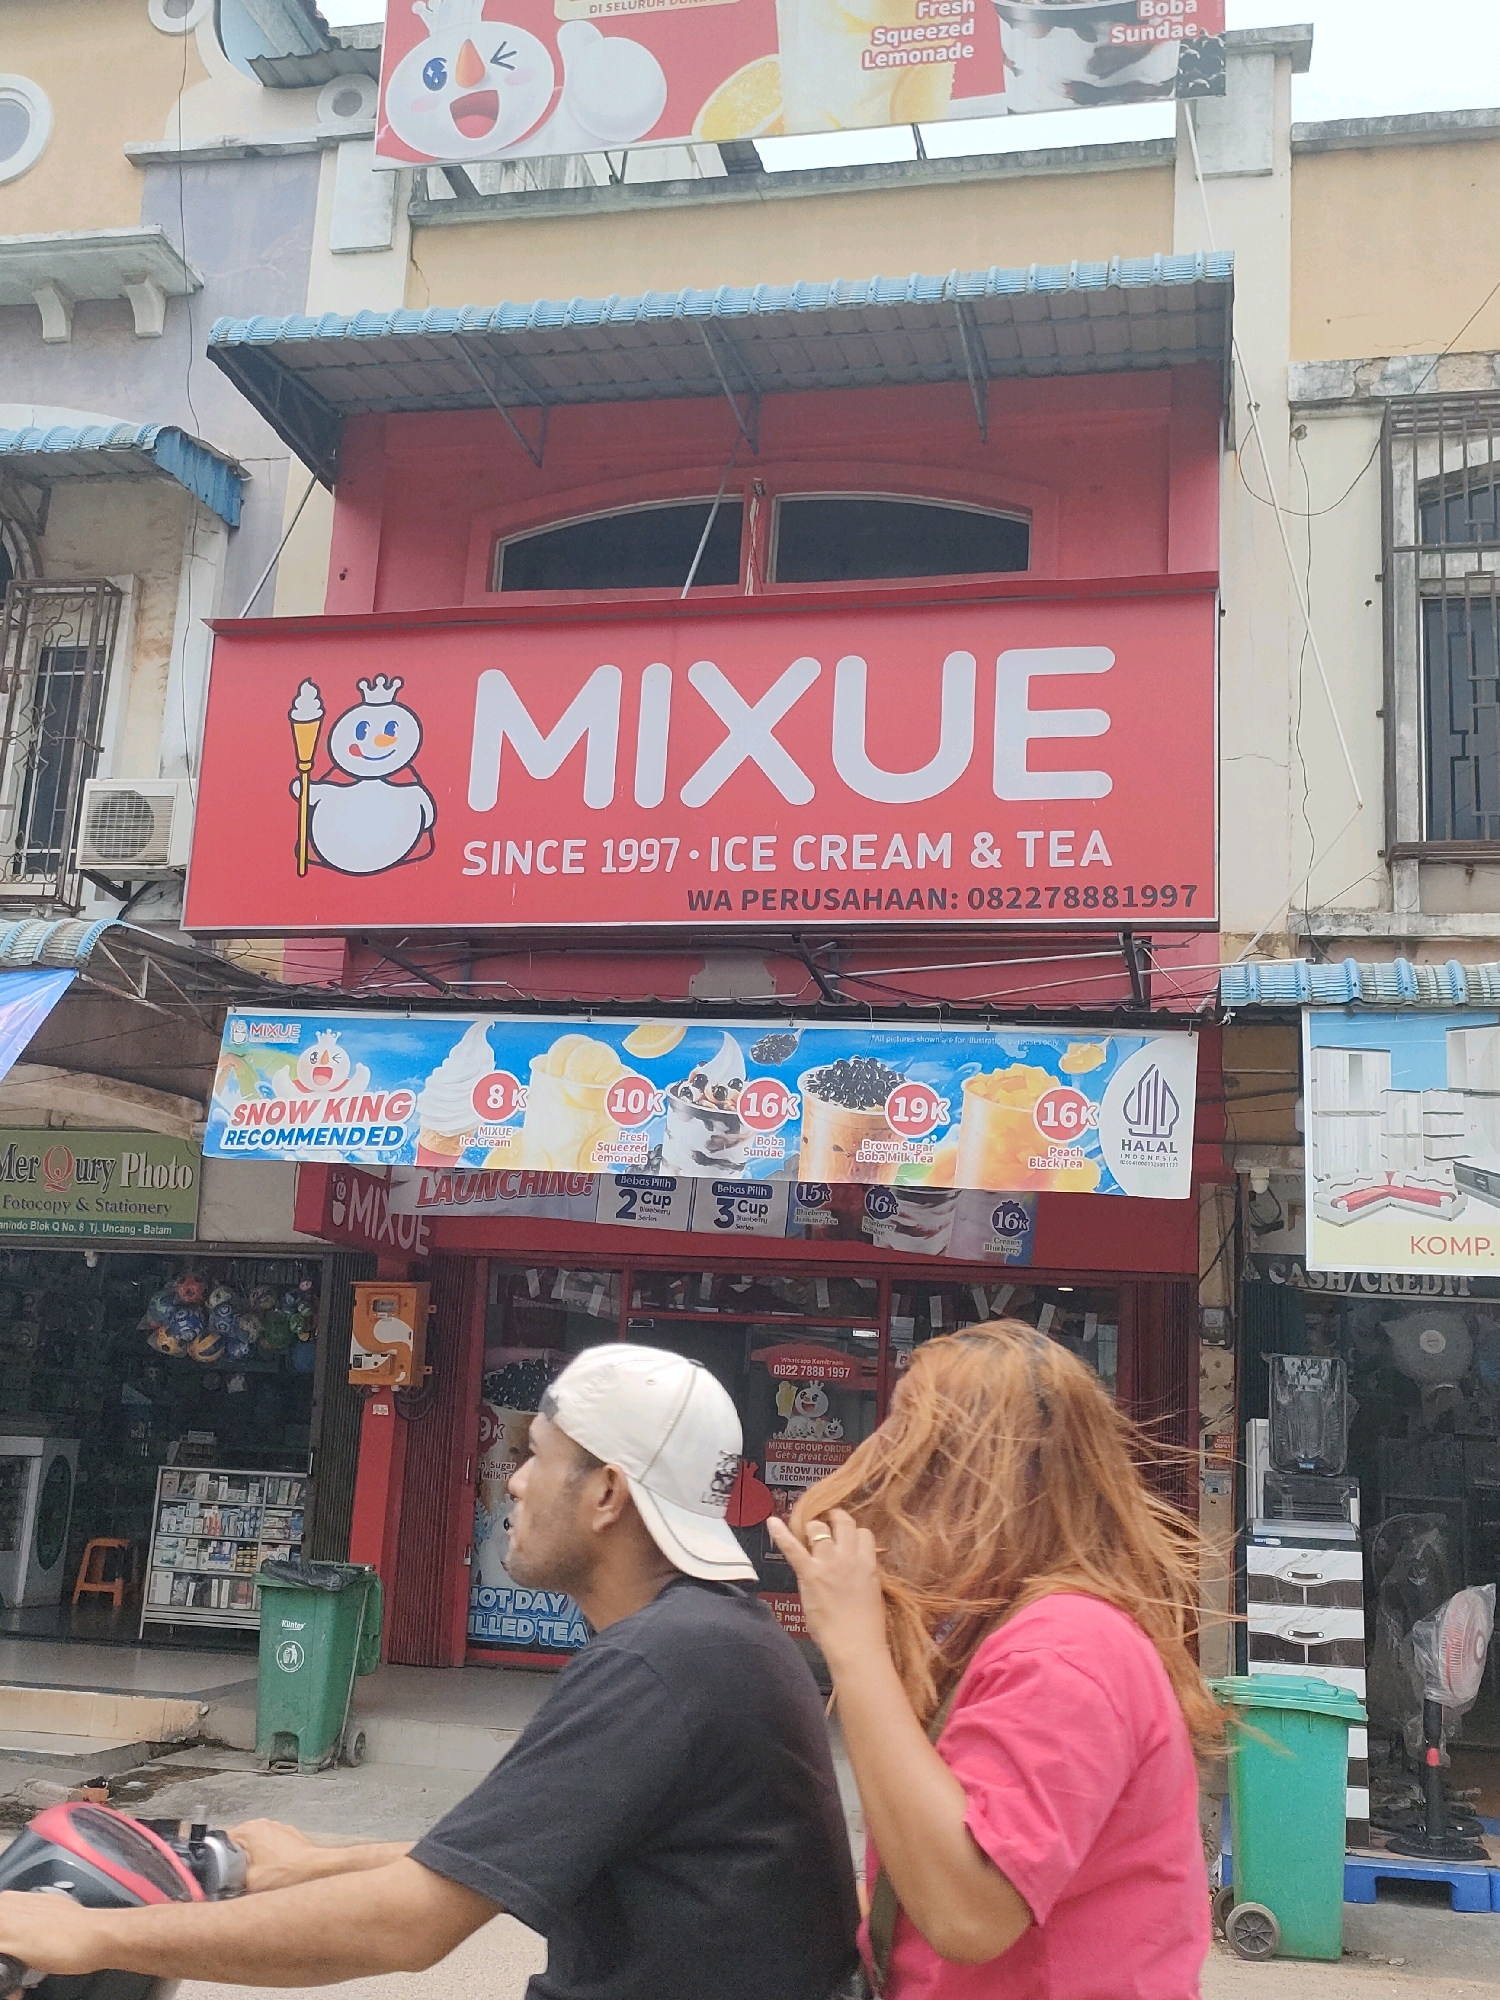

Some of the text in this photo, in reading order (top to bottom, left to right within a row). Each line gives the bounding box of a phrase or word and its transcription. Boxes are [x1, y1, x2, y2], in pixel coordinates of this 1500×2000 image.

[589, 4, 602, 14] DI
[606, 0, 666, 12] SELURUH
[917, 0, 976, 19] Fresh
[1138, 0, 1198, 18] Boba
[872, 19, 975, 47] Squeezed
[1110, 22, 1198, 44] Sundae
[863, 43, 975, 69] Lemonade
[468, 646, 1116, 812] MIXUE
[462, 839, 587, 876] SINCE
[601, 837, 681, 874] 1997
[709, 836, 778, 872] ICE
[793, 832, 952, 871] CREAM
[970, 831, 1003, 869] &
[1017, 829, 1113, 868] TEA
[687, 884, 1199, 911] WA PERUSAHAAN: 082278881997
[250, 1023, 301, 1038] MIXUE
[886, 1035, 915, 1045] pictures
[916, 1035, 940, 1044] shown
[954, 1036, 966, 1044] for
[231, 1091, 414, 1128] SNOW KING
[610, 1088, 665, 1115] 10K
[744, 1092, 799, 1119] 16K
[892, 1096, 949, 1123] 19K
[1040, 1102, 1099, 1129] 16K
[224, 1125, 405, 1148] RECOMMENDED
[478, 1125, 513, 1137] MIXUE
[618, 1131, 649, 1143] Fresh
[460, 1136, 512, 1148] Ice Cream
[596, 1142, 648, 1154] Squeezed
[756, 1136, 785, 1148] Boba
[862, 1140, 935, 1156] Brown Sugar
[1121, 1138, 1179, 1154] HALAL
[590, 1152, 649, 1165] Lemonade
[742, 1147, 784, 1159] Sundae
[856, 1151, 935, 1165] Boba Milk Tea
[1048, 1147, 1084, 1159] Peach
[1120, 1153, 1179, 1162] INDONESIA
[119, 1151, 194, 1190] Photo
[1028, 1157, 1084, 1170] Black Tea
[415, 1169, 595, 1208] LAUNCHING!
[620, 1175, 650, 1187] Bebas
[717, 1185, 768, 1197] Bebas Pilih
[3, 1194, 173, 1217] Fotocopy & Stationery
[615, 1188, 672, 1221] 2 Cup
[348, 1178, 431, 1257] MIXUE
[713, 1197, 770, 1230] 3 Cup
[825, 1217, 838, 1225] Tea
[30, 1220, 50, 1231] Blok
[51, 1221, 60, 1232] Q
[61, 1221, 77, 1232] No.
[79, 1222, 85, 1232] 8
[102, 1223, 136, 1236] Uncang
[143, 1224, 172, 1236] Batam
[984, 1243, 1020, 1255] Blueberry
[1410, 1235, 1496, 1257] KOMP.
[1267, 1262, 1474, 1297] CASH/CREDIT
[773, 1364, 851, 1378] 0822 7888 1997
[768, 1441, 853, 1453] MIXUE GROUP ORDER
[775, 1450, 791, 1459] Get
[797, 1452, 822, 1462] great
[489, 1460, 517, 1472] Sugar
[779, 1465, 811, 1475] SNOW
[483, 1470, 501, 1480] Milk
[779, 1474, 826, 1483] RECOMMEN
[515, 1589, 566, 1615] DAY
[538, 1620, 588, 1643] TEA
